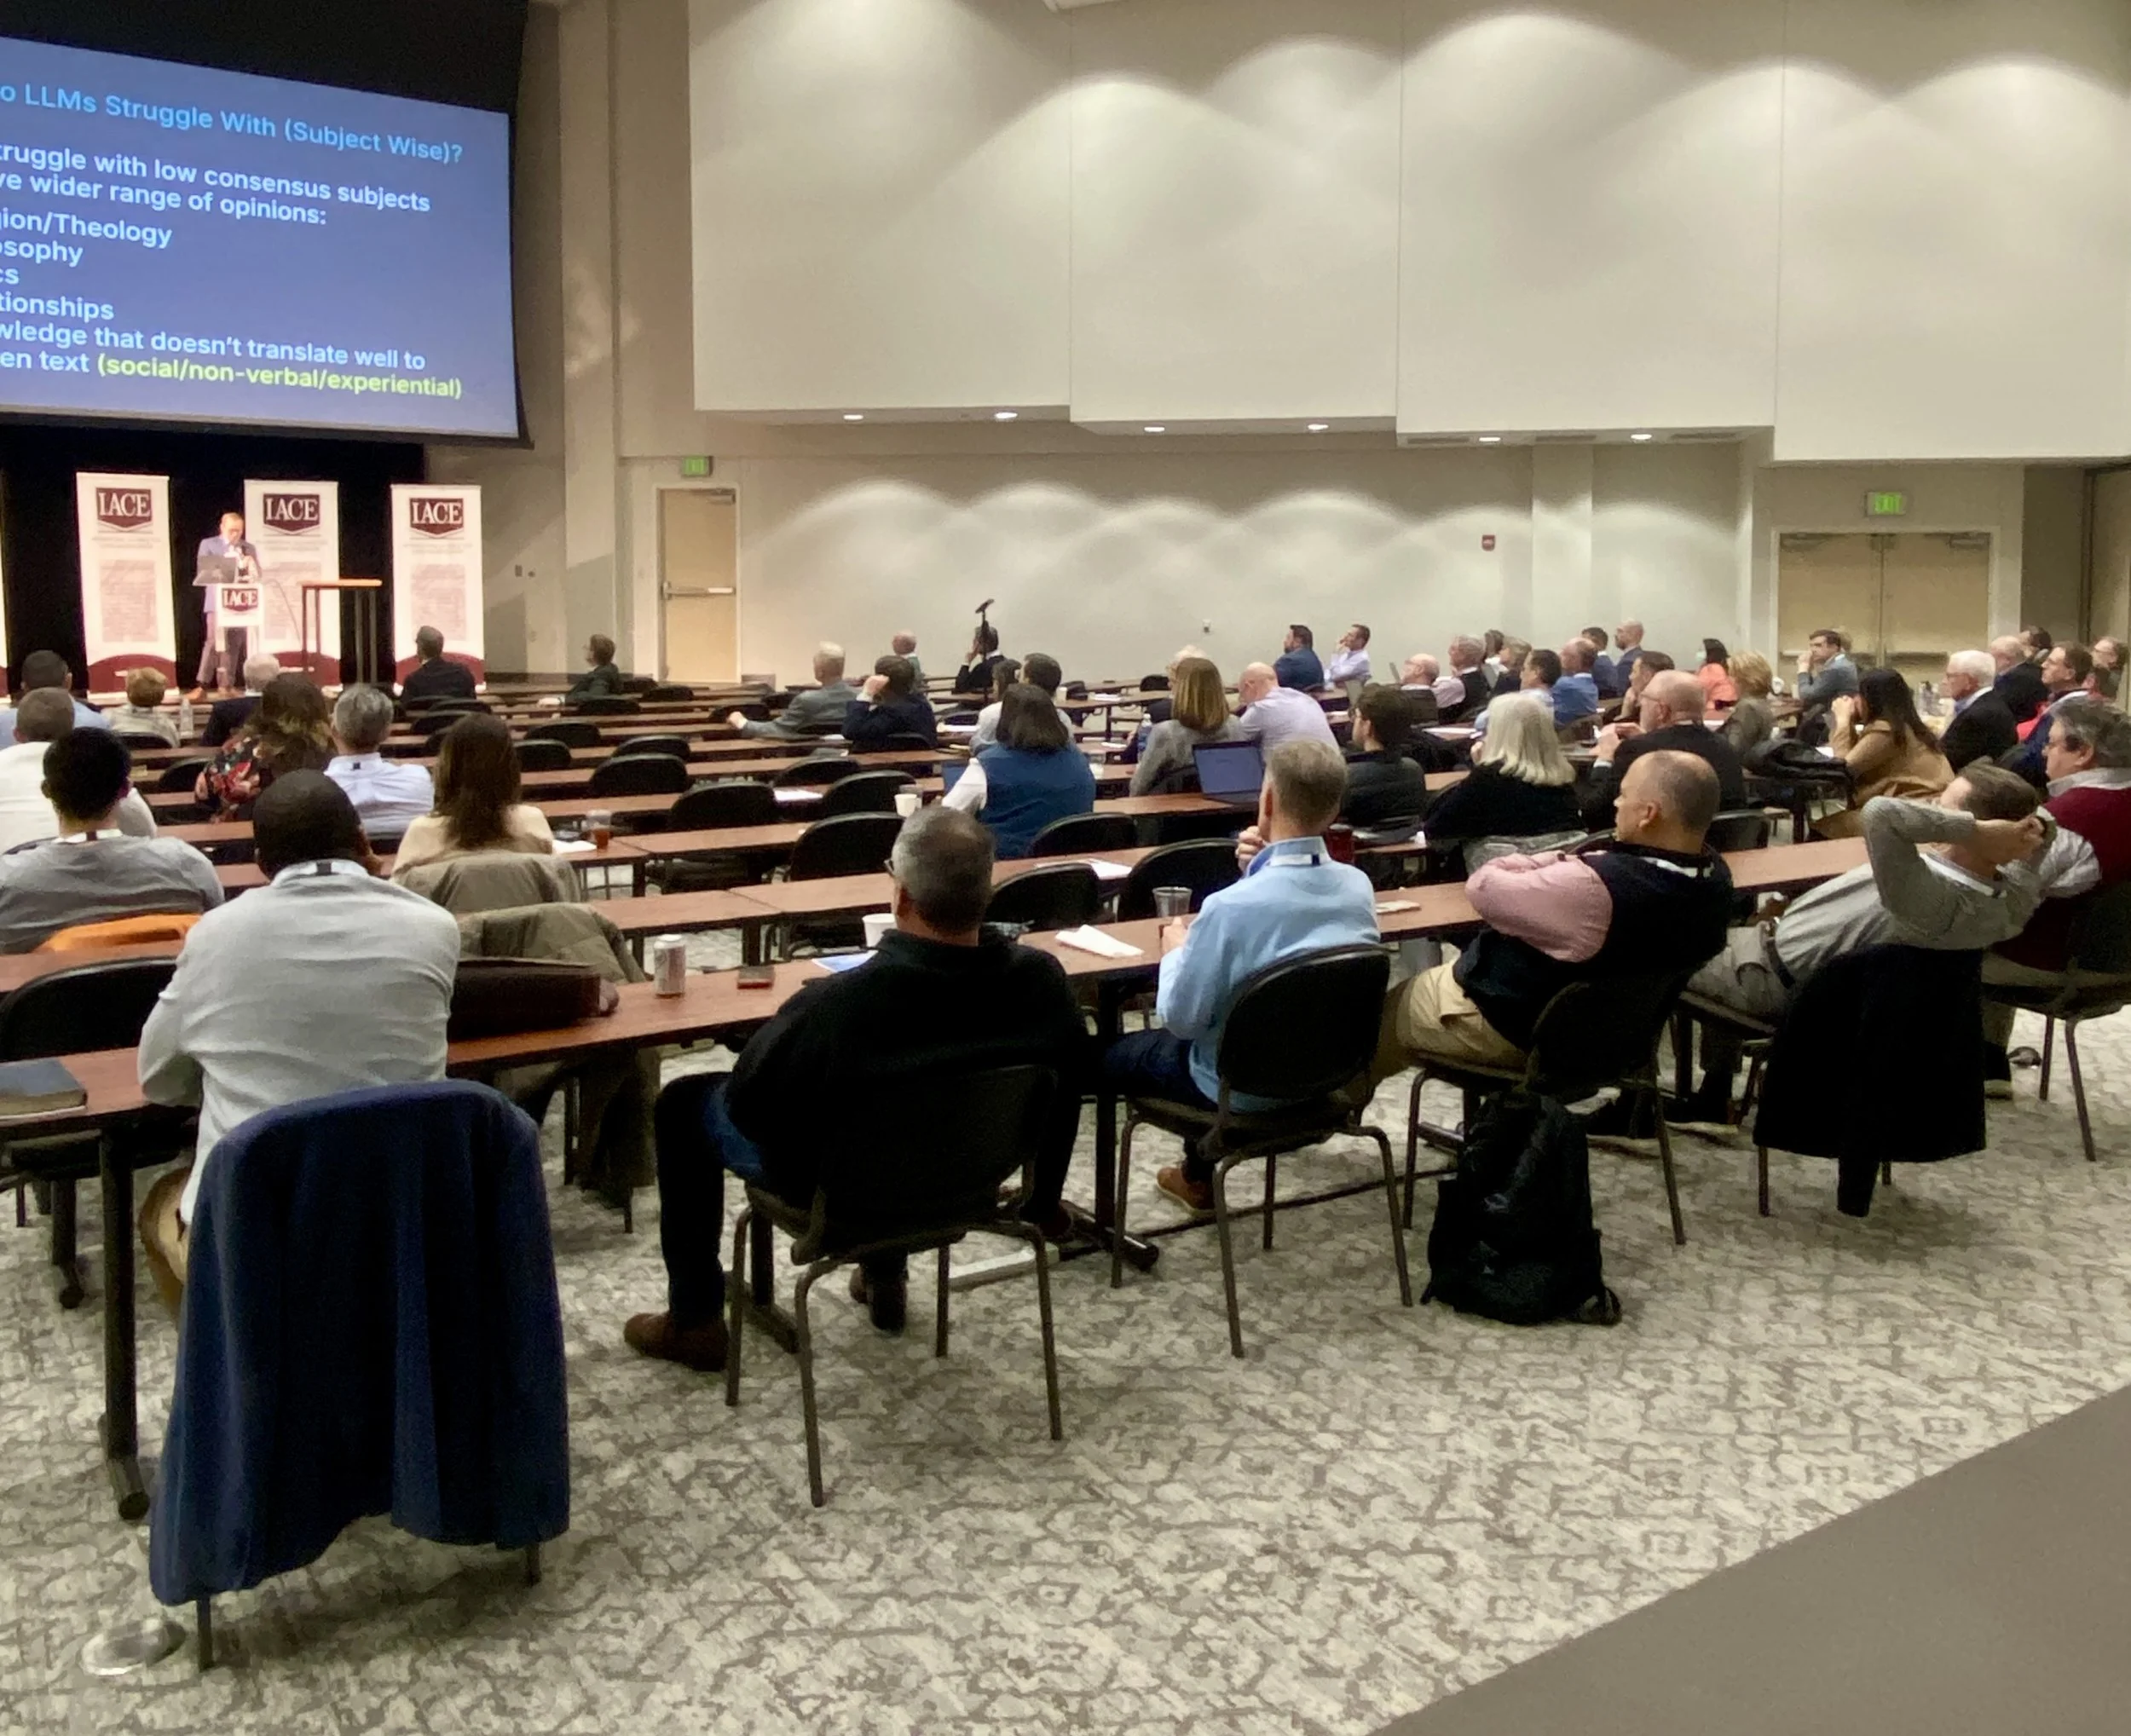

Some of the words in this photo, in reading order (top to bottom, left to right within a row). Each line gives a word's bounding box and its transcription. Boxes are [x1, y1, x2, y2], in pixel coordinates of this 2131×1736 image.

[26, 84, 96, 112] LLMs
[106, 95, 212, 130] Struggle
[221, 111, 275, 137] With
[285, 118, 380, 152] (Subject
[388, 135, 462, 164] Wise)?
[0, 145, 86, 171] ruggle
[94, 154, 147, 177] with
[155, 159, 197, 182] low
[205, 170, 331, 199] consensus
[338, 186, 430, 211] subjects
[30, 174, 103, 199] wider
[110, 185, 181, 211] range
[188, 192, 213, 211] of
[220, 198, 326, 225] opinions:
[0, 207, 172, 249] ion/Theology
[0, 240, 83, 267] sophy
[94, 327, 143, 349] that
[151, 332, 241, 356] doesn't
[247, 339, 348, 364] translate
[355, 349, 398, 368] well
[404, 351, 425, 370] to
[39, 351, 90, 372] text
[98, 353, 462, 400] (social/non-verbal/experiential)
[98, 492, 151, 517] IACE
[265, 498, 319, 521] IACE
[412, 501, 462, 524] IACE
